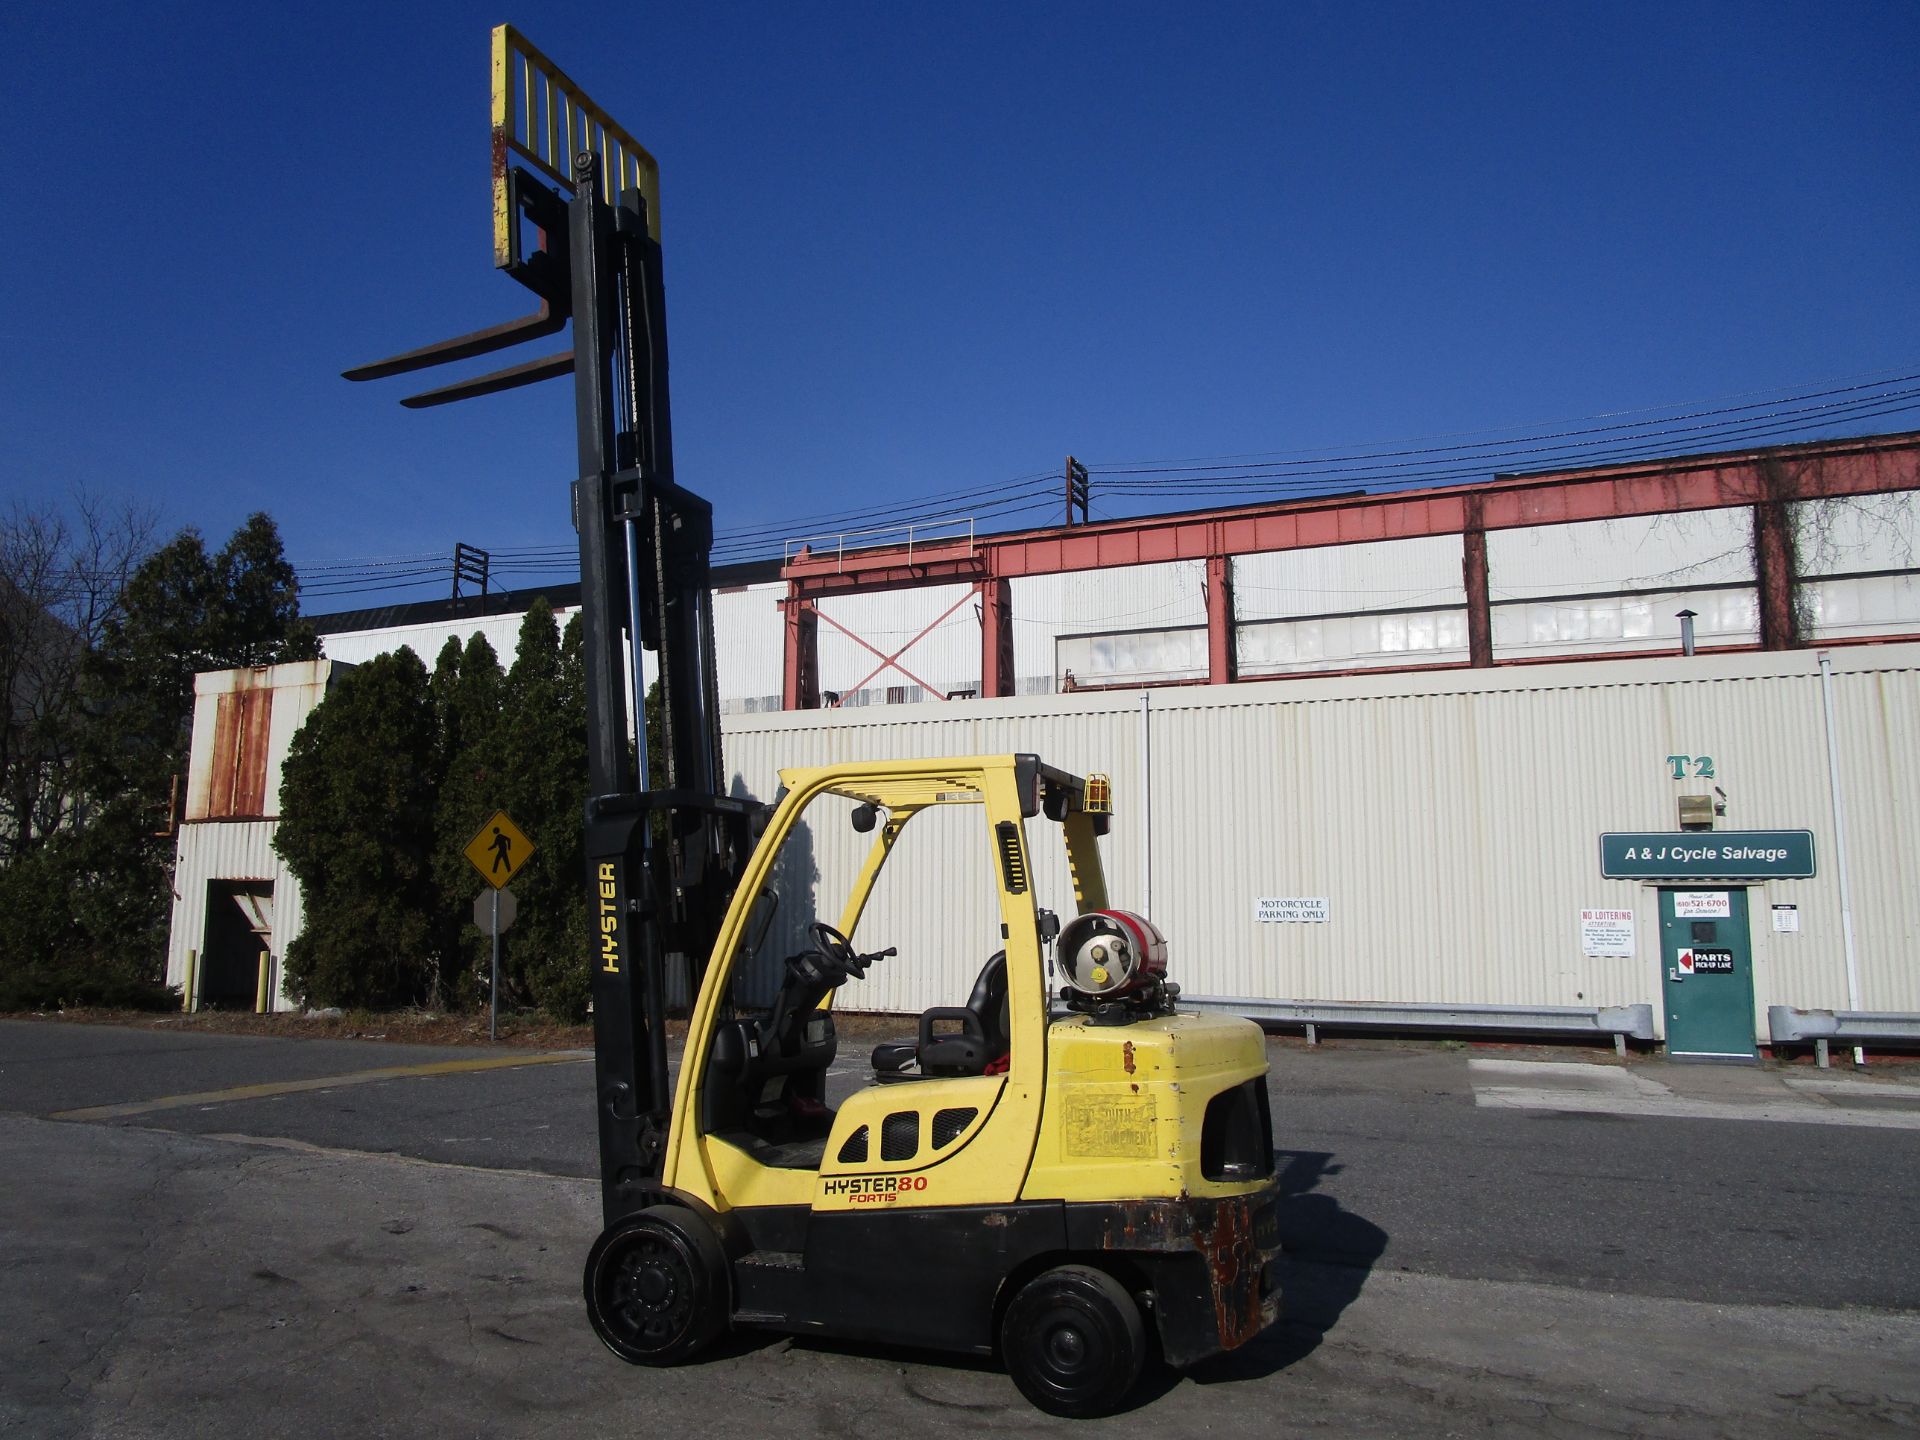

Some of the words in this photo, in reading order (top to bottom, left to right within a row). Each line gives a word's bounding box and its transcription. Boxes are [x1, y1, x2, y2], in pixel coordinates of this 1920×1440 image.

[1625, 847, 1637, 860] A
[1641, 847, 1652, 860] &
[1657, 847, 1666, 860] J
[1670, 846, 1717, 862] Cycle
[1721, 846, 1787, 862] Salvage
[1261, 900, 1322, 909] MOTORCYCLE
[599, 862, 619, 972] HYSTER
[1258, 910, 1299, 919] PARKING
[1302, 910, 1326, 918] ONLY
[1582, 911, 1592, 920] NO
[1595, 911, 1632, 921] LOITERING
[1694, 953, 1731, 962] PARTS
[1695, 961, 1716, 969] PICK-UP
[1717, 961, 1732, 969] LANE
[824, 1177, 897, 1195] HYSTER
[898, 1176, 928, 1191] 80
[849, 1194, 897, 1203] FORTIS
